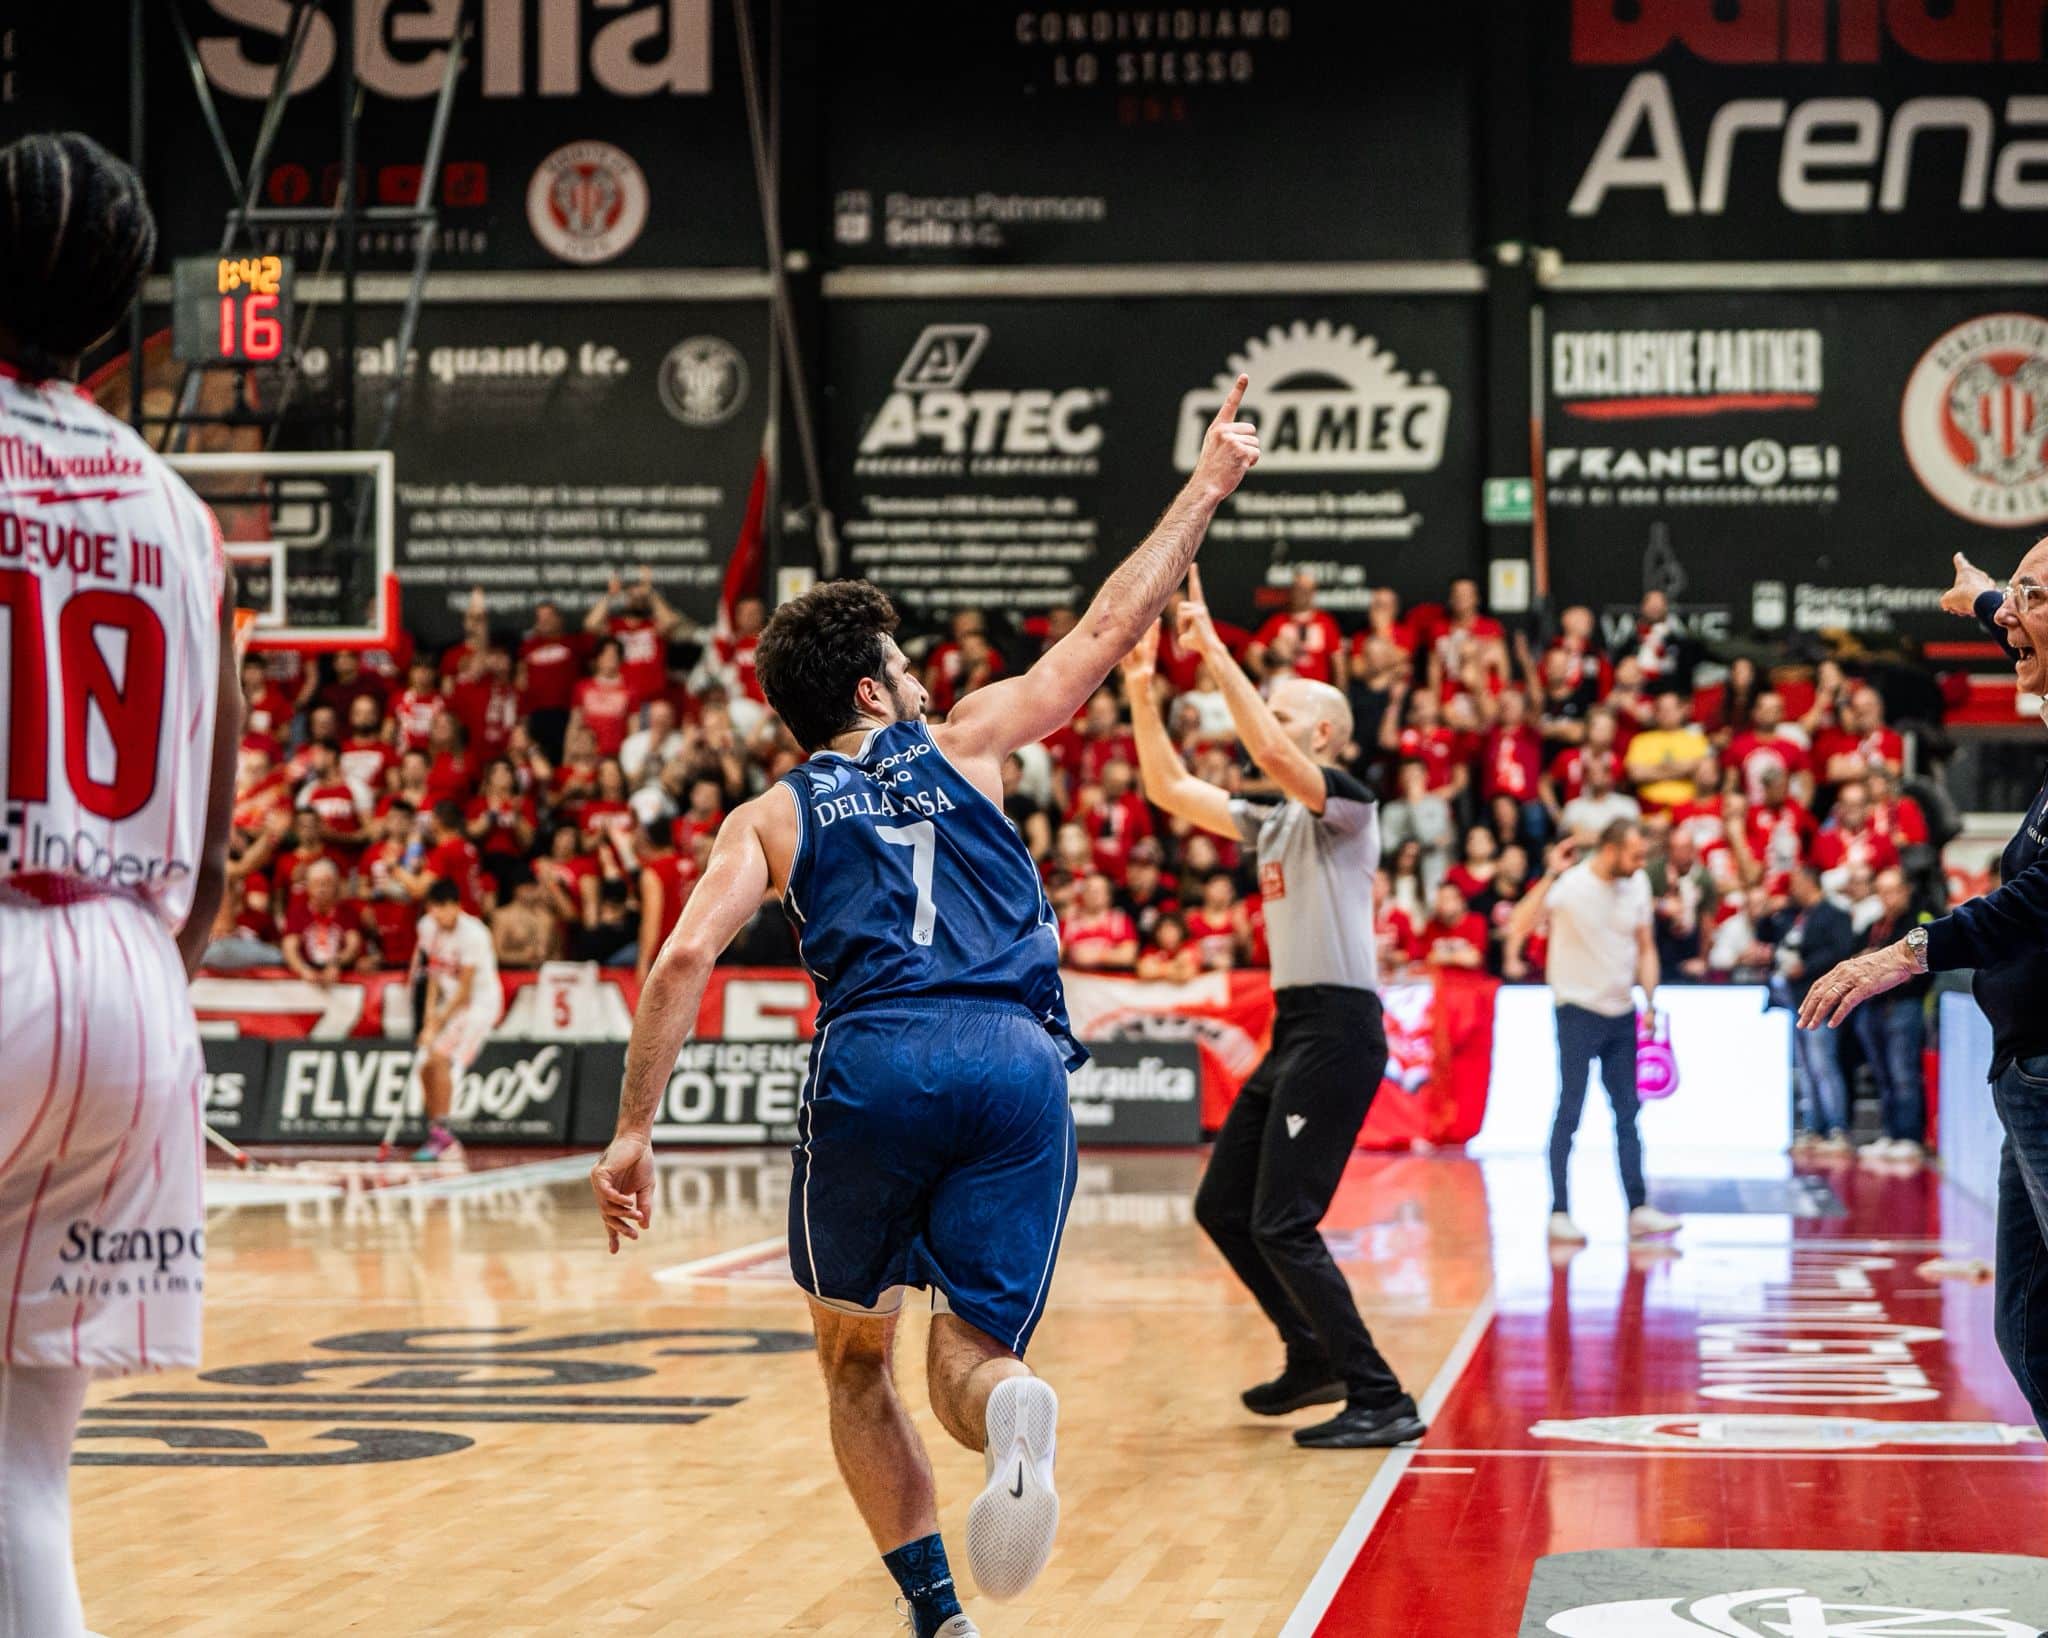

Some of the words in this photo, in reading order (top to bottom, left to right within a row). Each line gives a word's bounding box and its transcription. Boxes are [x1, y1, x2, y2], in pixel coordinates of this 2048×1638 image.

[1016, 8, 1291, 43] CONDIVIDIAMO
[1055, 53, 1098, 86] LO
[1117, 50, 1253, 83] STESSO
[218, 256, 282, 294] 1:42
[220, 294, 283, 360] 16
[430, 342, 568, 384] quanto
[1553, 331, 1695, 394] EXCLUSIVE
[1700, 330, 1821, 392] PARTNER
[858, 388, 1103, 454] ARTEC
[1195, 404, 1429, 451] AMEC
[0, 434, 143, 482] Milwaukee
[1547, 439, 1840, 485] FRANCIOSI
[0, 511, 118, 580] DEVOE
[0, 567, 167, 822] 10
[814, 791, 898, 828] DELLA
[875, 819, 936, 947] 7
[653, 1070, 807, 1124] OTE
